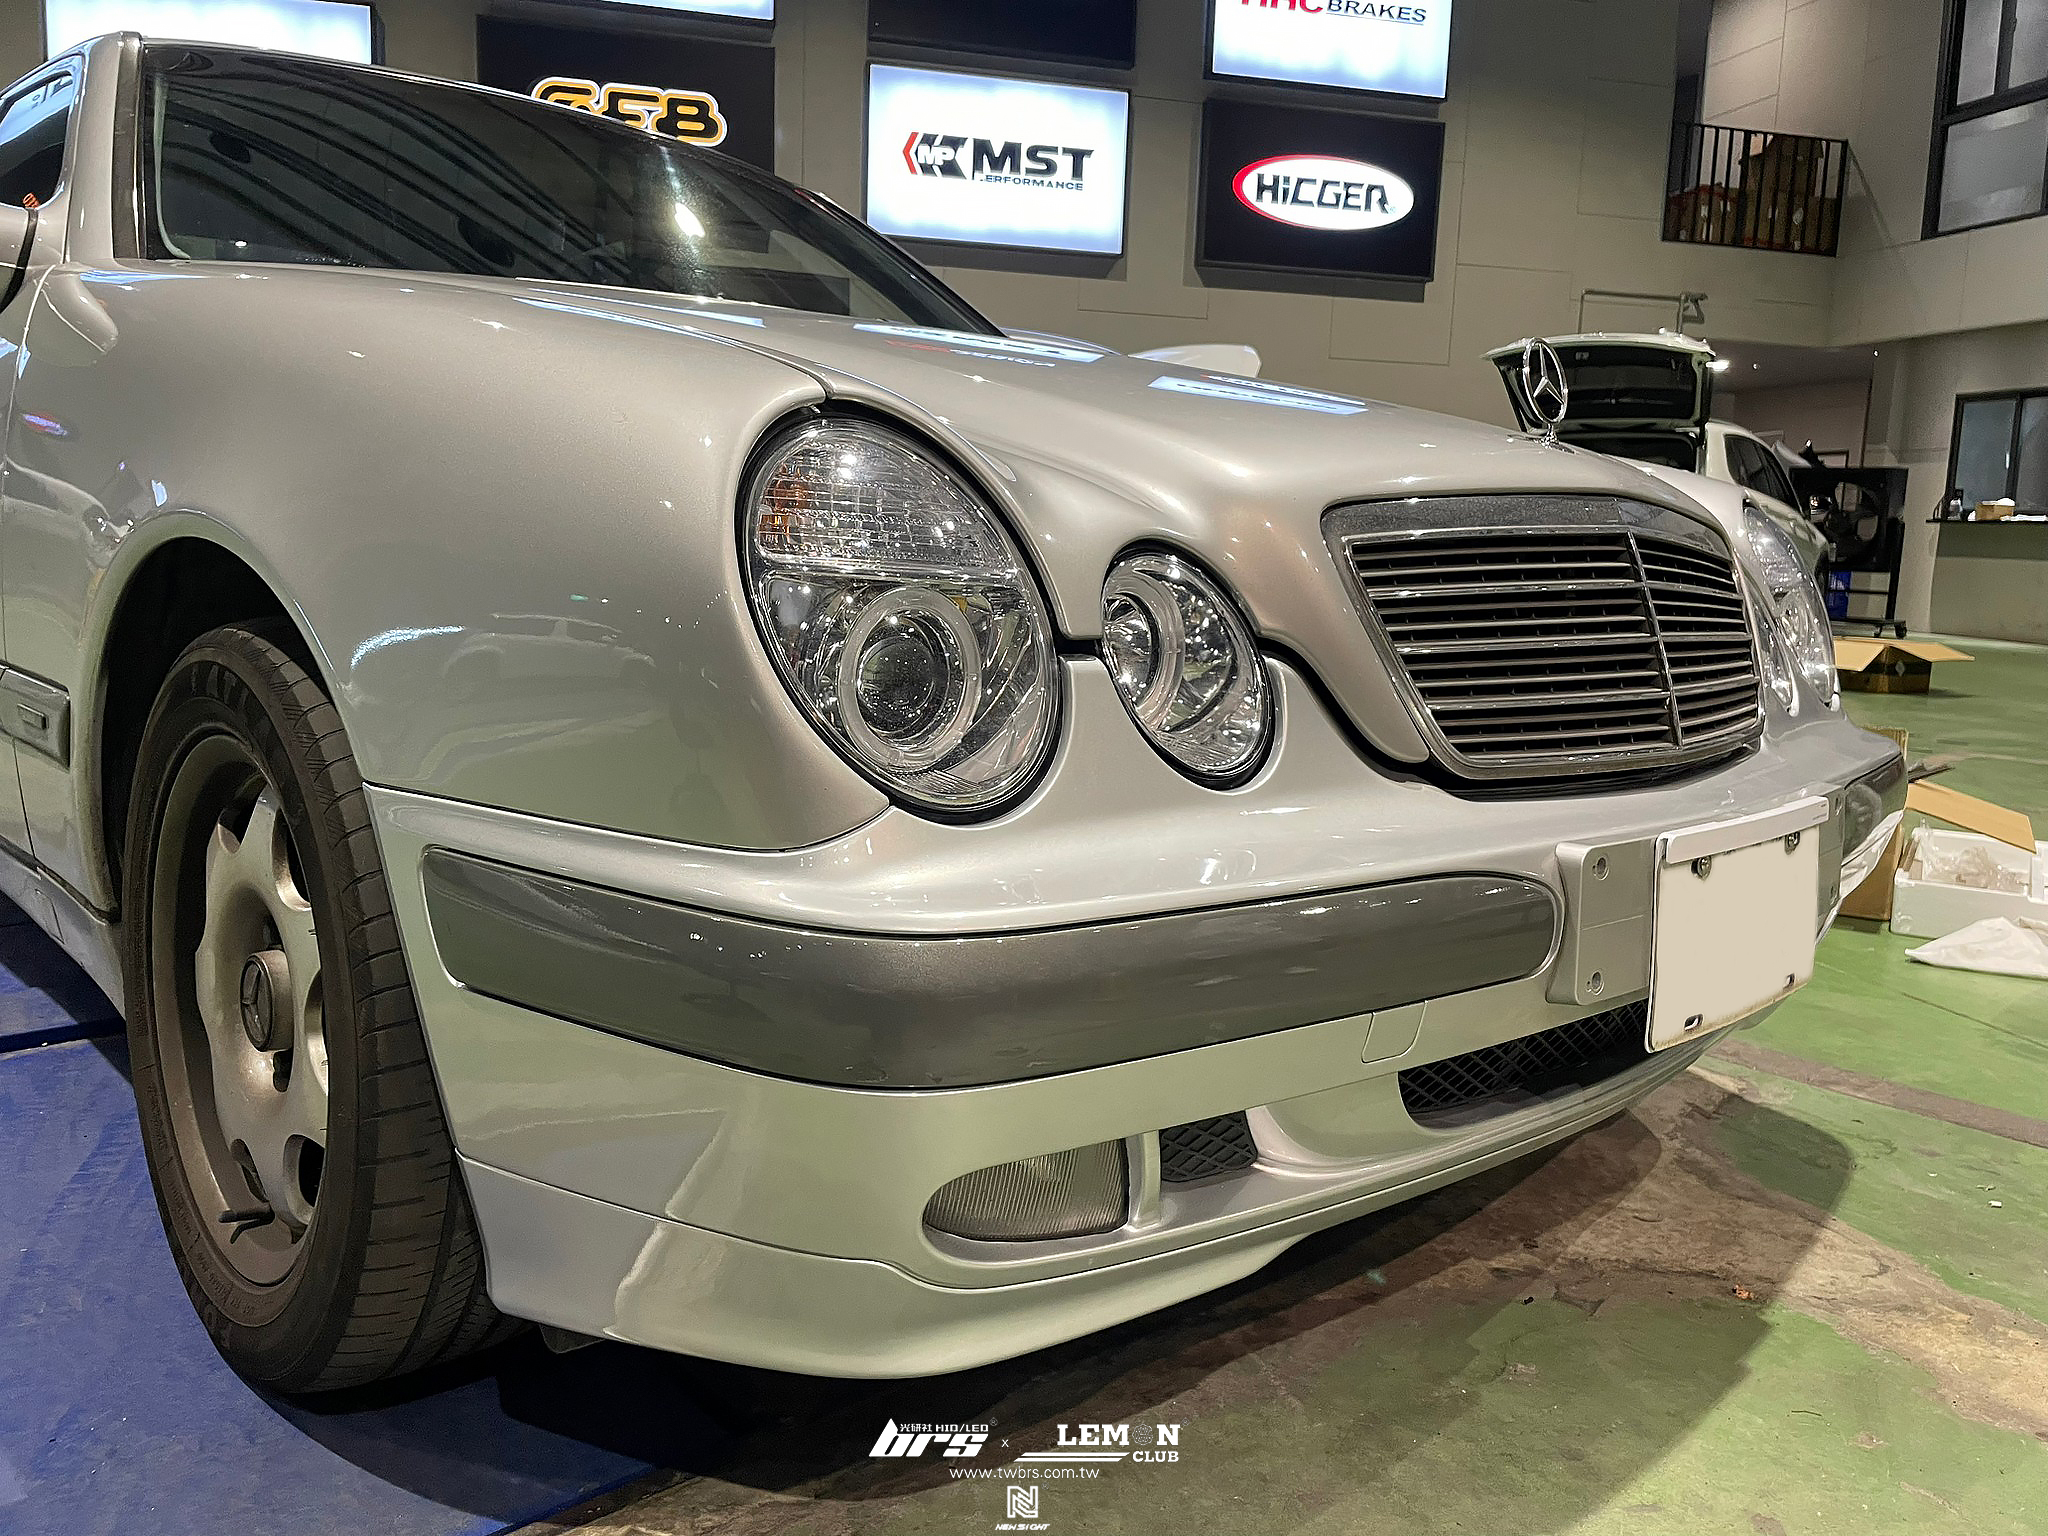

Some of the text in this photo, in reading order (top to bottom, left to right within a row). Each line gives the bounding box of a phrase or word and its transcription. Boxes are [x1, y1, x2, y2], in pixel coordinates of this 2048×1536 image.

[1326, 0, 1427, 22] BRAKES
[972, 138, 1095, 181] MST
[980, 174, 1084, 191] ERFORMANCE
